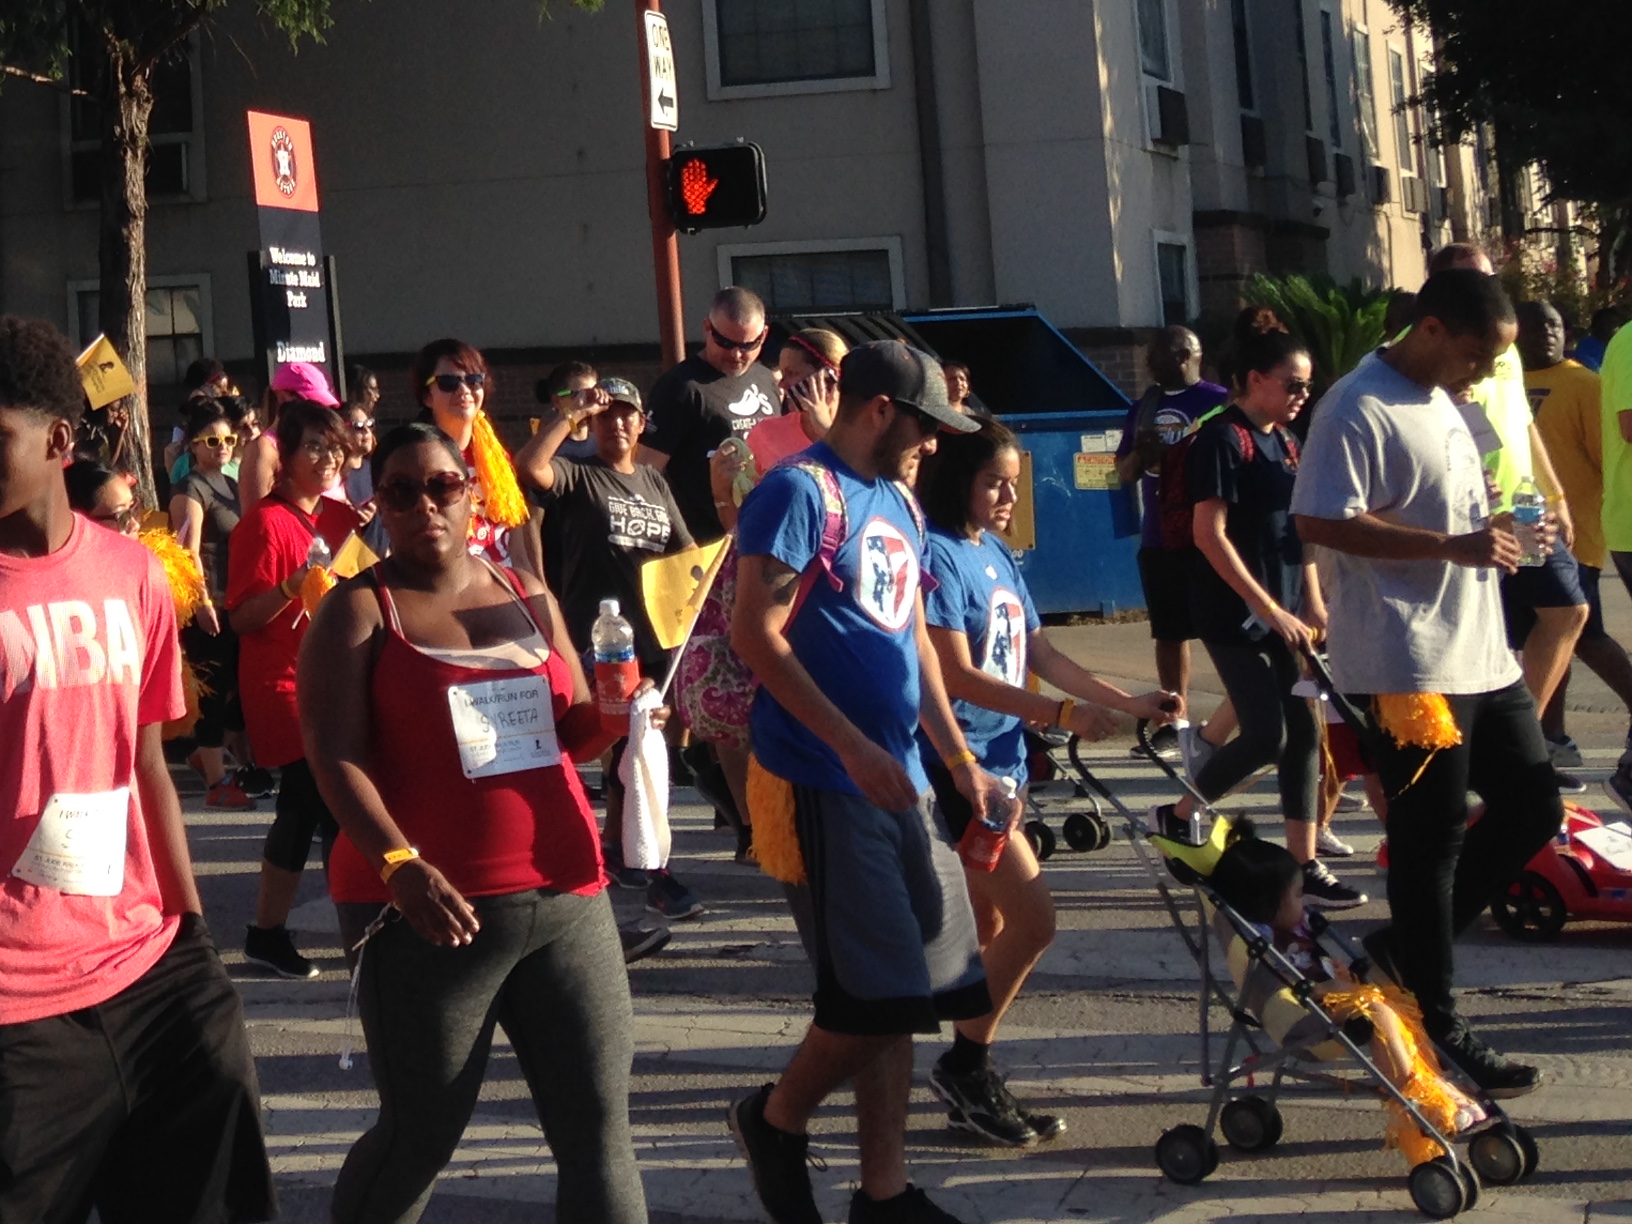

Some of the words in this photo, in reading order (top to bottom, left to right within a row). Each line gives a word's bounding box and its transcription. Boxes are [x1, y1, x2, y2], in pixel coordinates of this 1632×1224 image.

[652, 23, 670, 51] ONE
[654, 56, 673, 81] WAY
[269, 247, 306, 266] Welcome
[307, 251, 316, 267] to
[269, 269, 298, 287] Minute
[299, 270, 321, 288] Maid
[286, 290, 307, 308] Park
[276, 340, 326, 363] Diamond
[609, 515, 671, 544] HOPE
[519, 689, 539, 700] FOR
